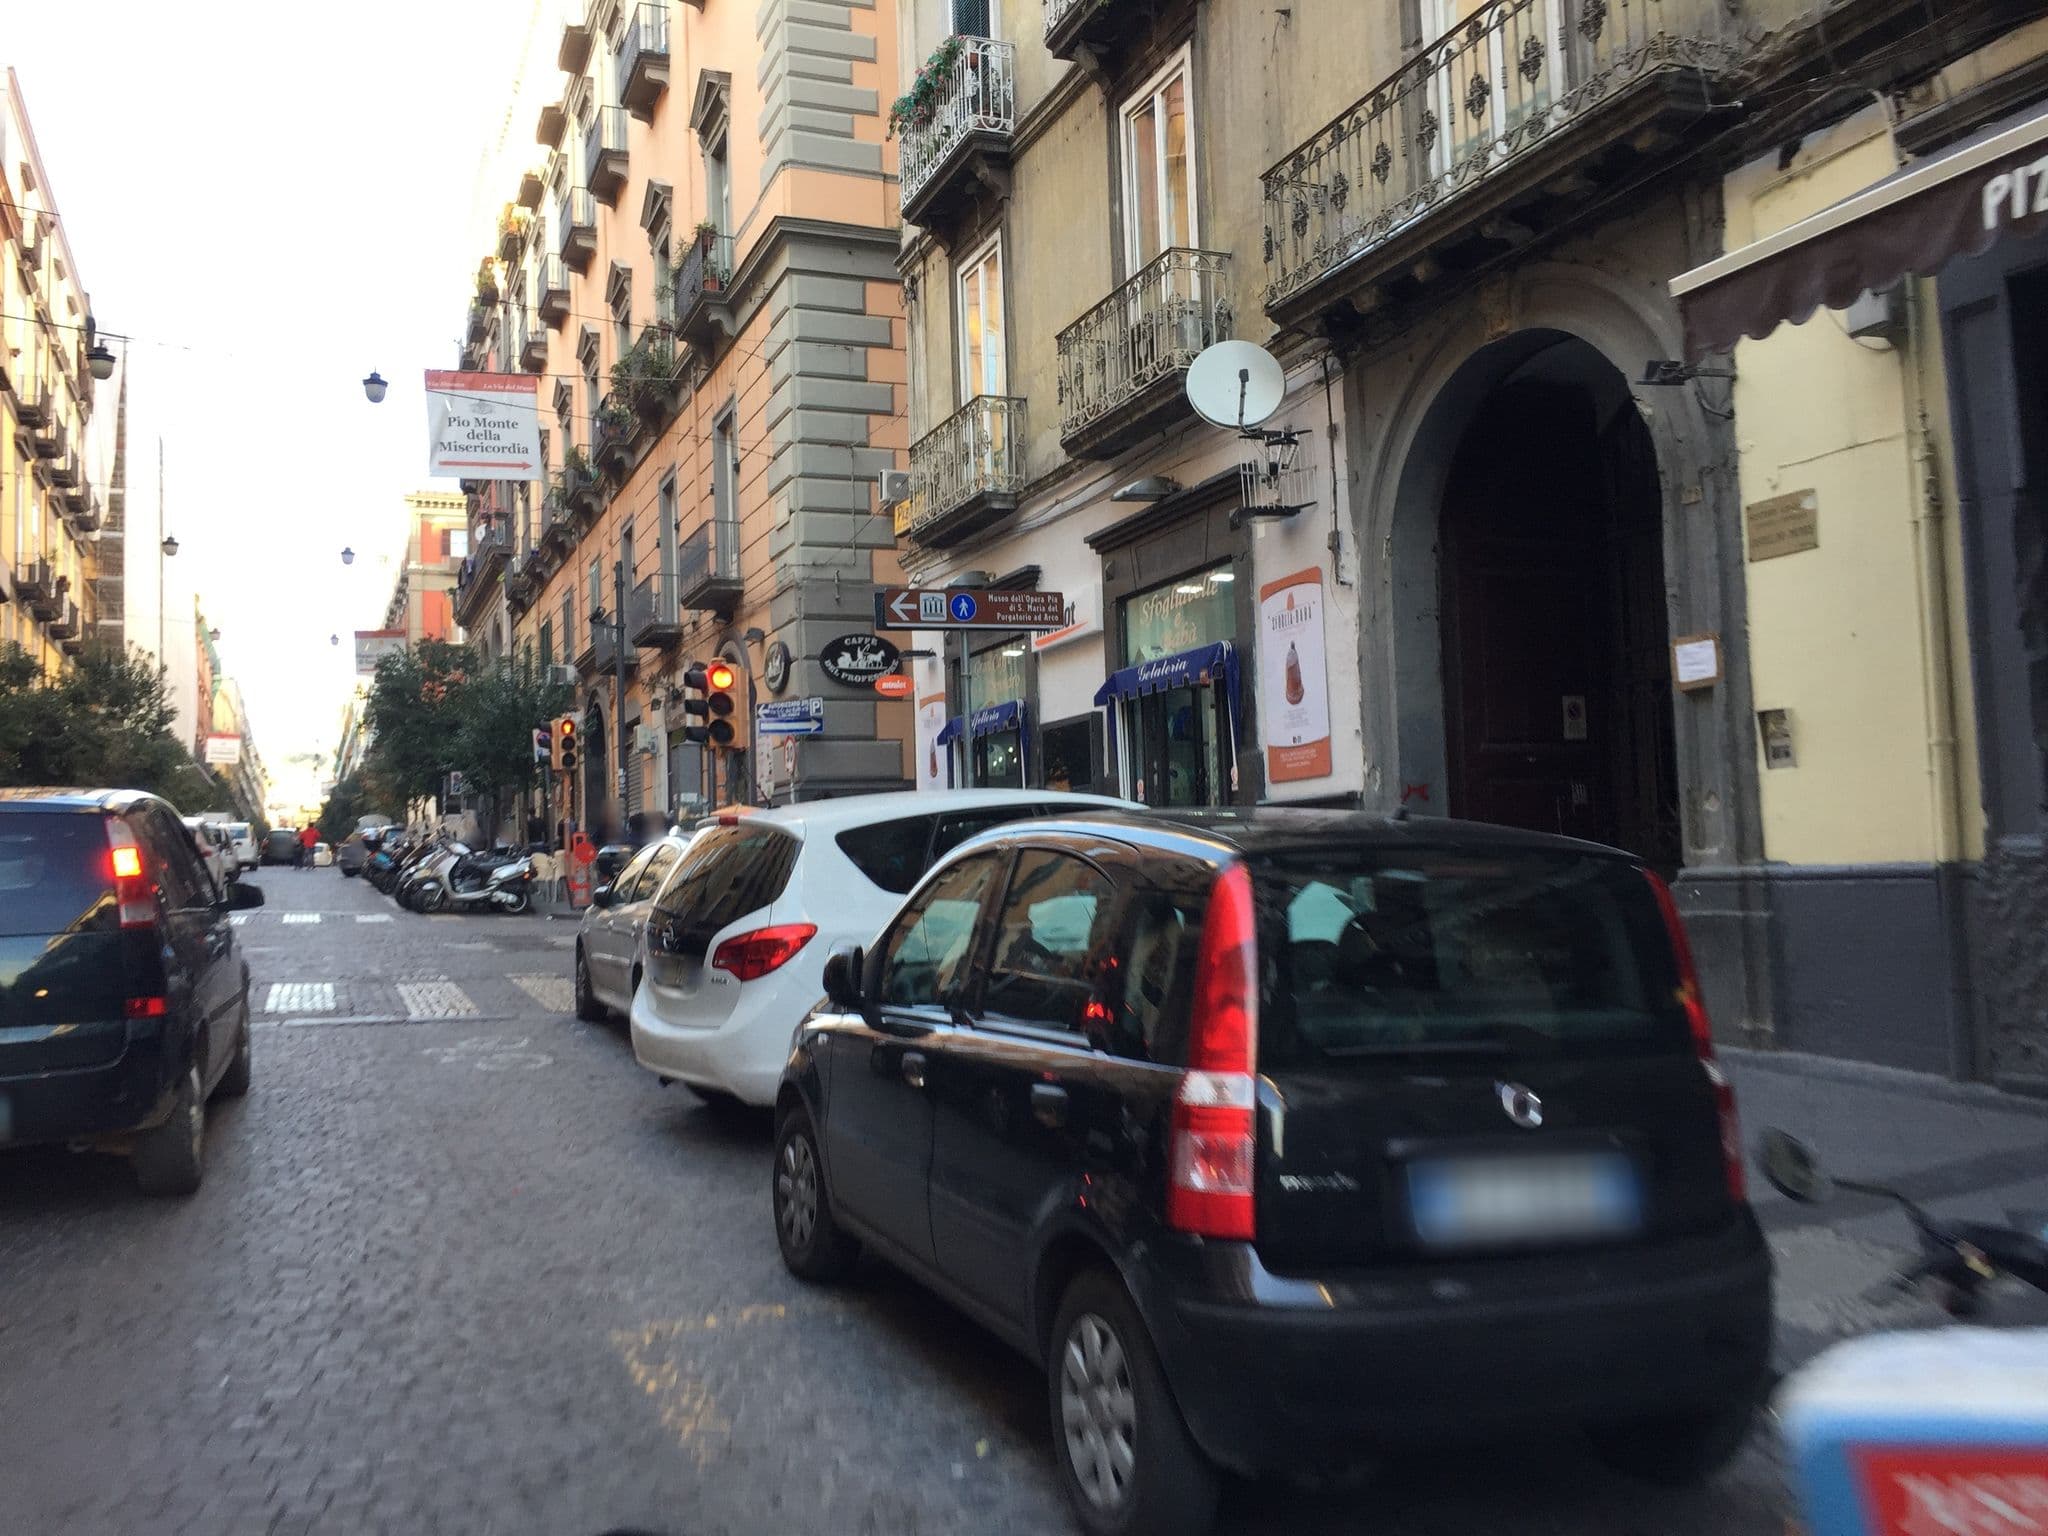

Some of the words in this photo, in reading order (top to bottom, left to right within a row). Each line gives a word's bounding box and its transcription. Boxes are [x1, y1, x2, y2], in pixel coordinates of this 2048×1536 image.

[447, 416, 470, 427] Pio
[474, 417, 519, 429] Monte
[466, 429, 501, 441] della
[439, 441, 529, 454] Misericordia
[988, 593, 1009, 602] Museo
[1010, 594, 1045, 604] dell'Opera
[1047, 594, 1058, 603] Pia
[1008, 603, 1016, 612] di
[1017, 604, 1025, 612] S.
[1027, 604, 1044, 612] Maria
[1047, 604, 1058, 612] del
[996, 612, 1032, 622] Purgatorio
[1033, 613, 1041, 621] ad
[1044, 613, 1059, 621] Arco
[1137, 659, 1187, 681] Gelateria
[812, 701, 820, 714] P
